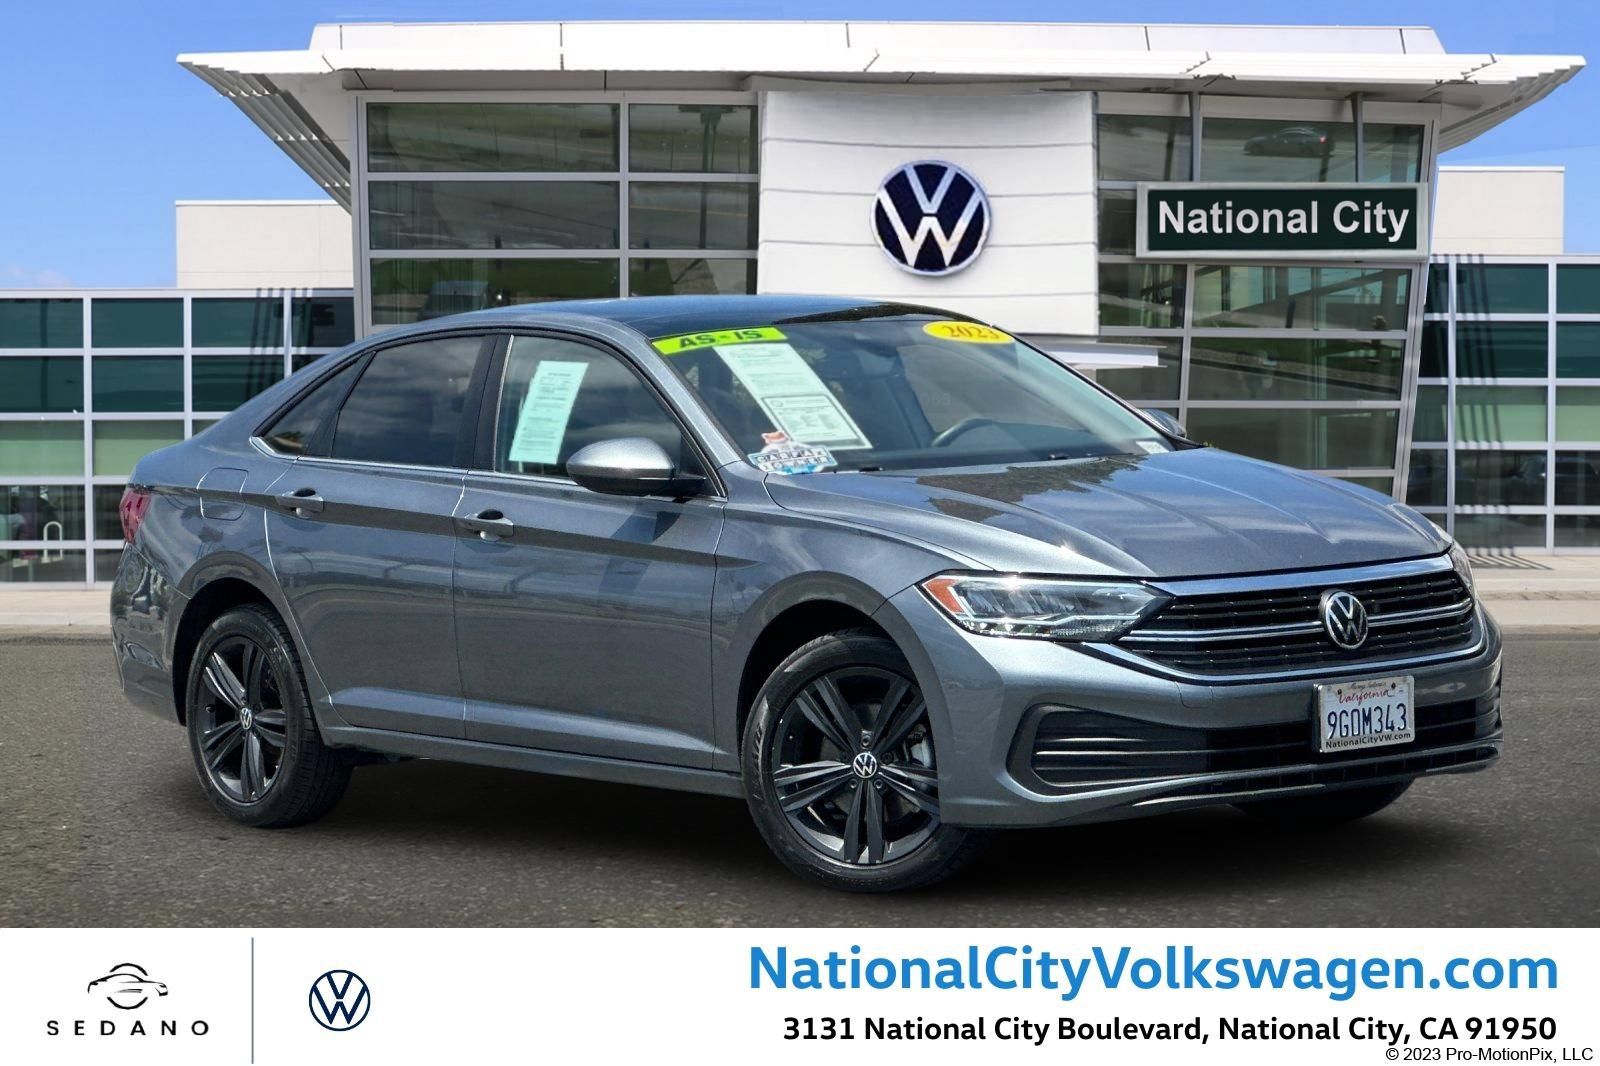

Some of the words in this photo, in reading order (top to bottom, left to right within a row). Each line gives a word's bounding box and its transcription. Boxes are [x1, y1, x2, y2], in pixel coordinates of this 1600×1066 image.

[1158, 200, 1318, 234] National
[1332, 200, 1410, 243] City
[941, 324, 1000, 339] 2023
[1325, 732, 1411, 750] NationalCityVW.com
